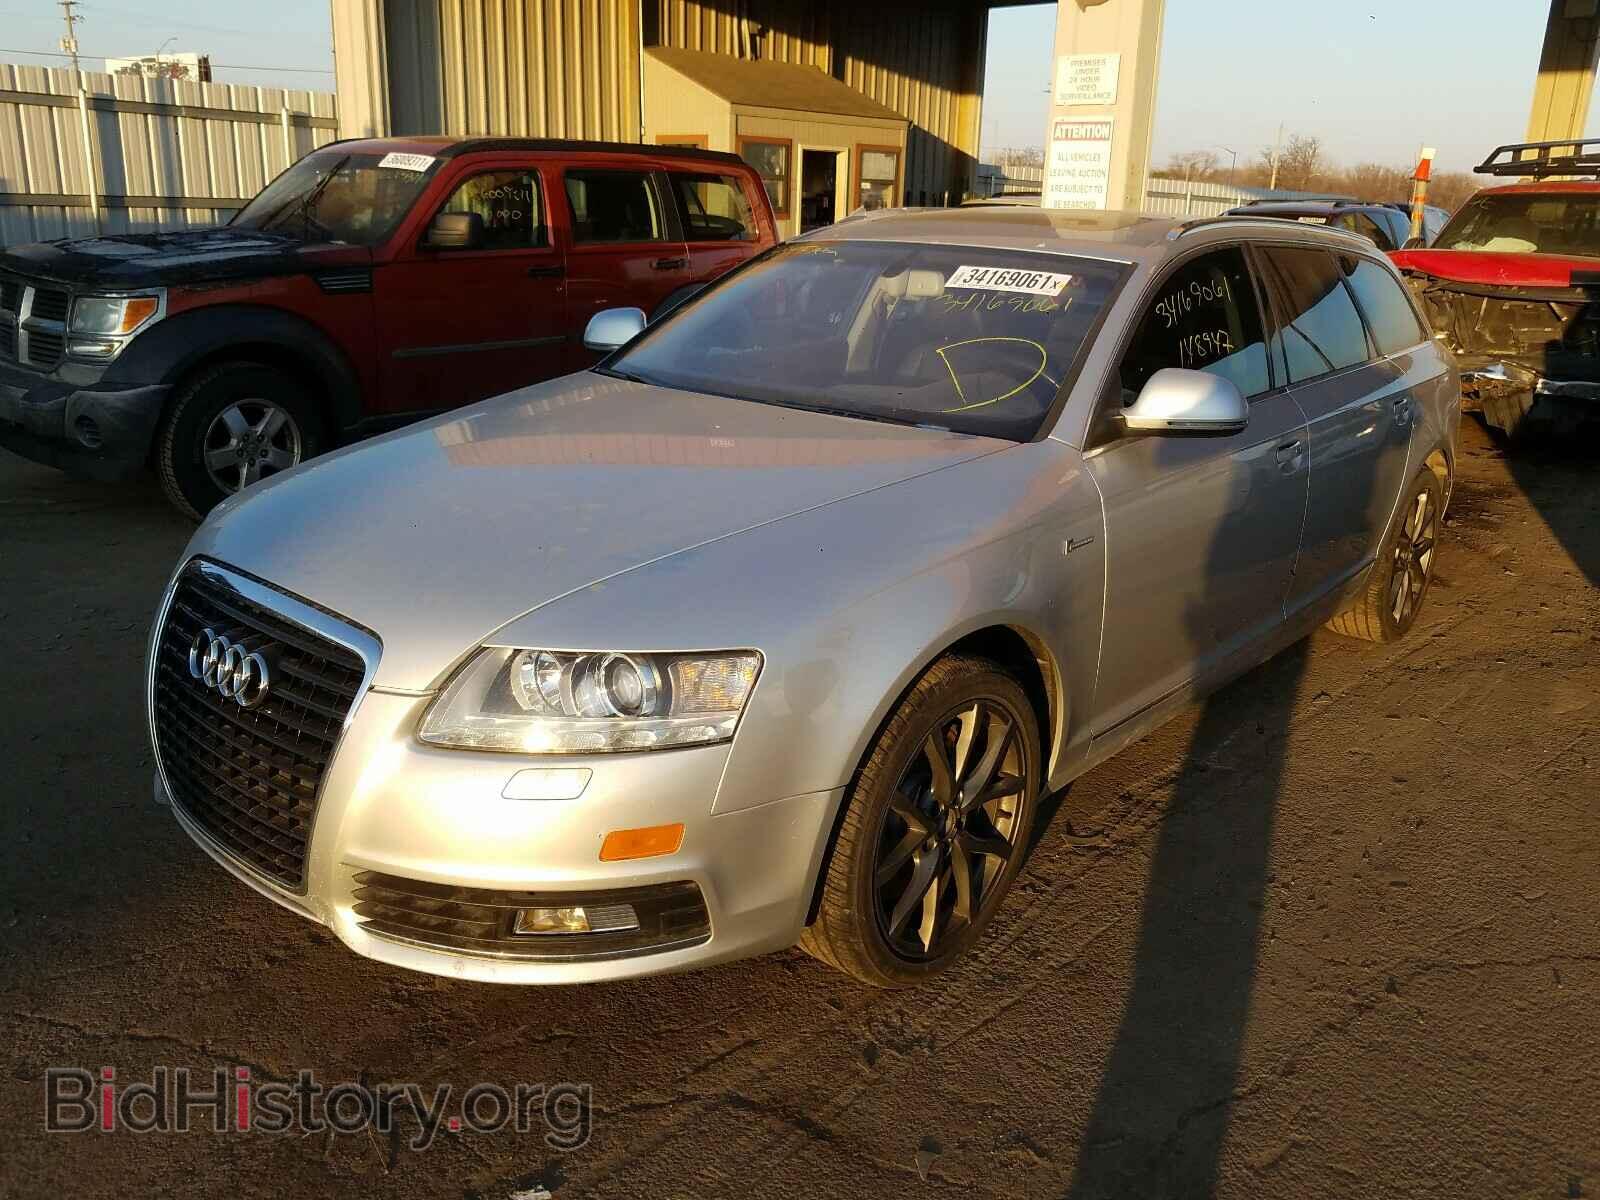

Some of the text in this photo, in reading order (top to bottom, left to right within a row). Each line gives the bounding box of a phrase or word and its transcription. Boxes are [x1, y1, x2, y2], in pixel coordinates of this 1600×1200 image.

[1070, 58, 1106, 67] PREMISES
[1075, 68, 1100, 76] UNDER
[1068, 76, 1078, 84] 24
[1076, 84, 1097, 92] VIDEO
[1060, 91, 1112, 100] SURVEILLANCE
[1055, 124, 1110, 139] ATTENTION
[1057, 152, 1101, 162] ALL VEHICLES
[1049, 168, 1106, 178] LEAVING AUCTION
[1050, 184, 1103, 194] ARE SUBJECT TO
[1053, 200, 1096, 209] BE SEARCHED
[1155, 276, 1232, 328] 34169061
[1179, 329, 1234, 369] 148947
